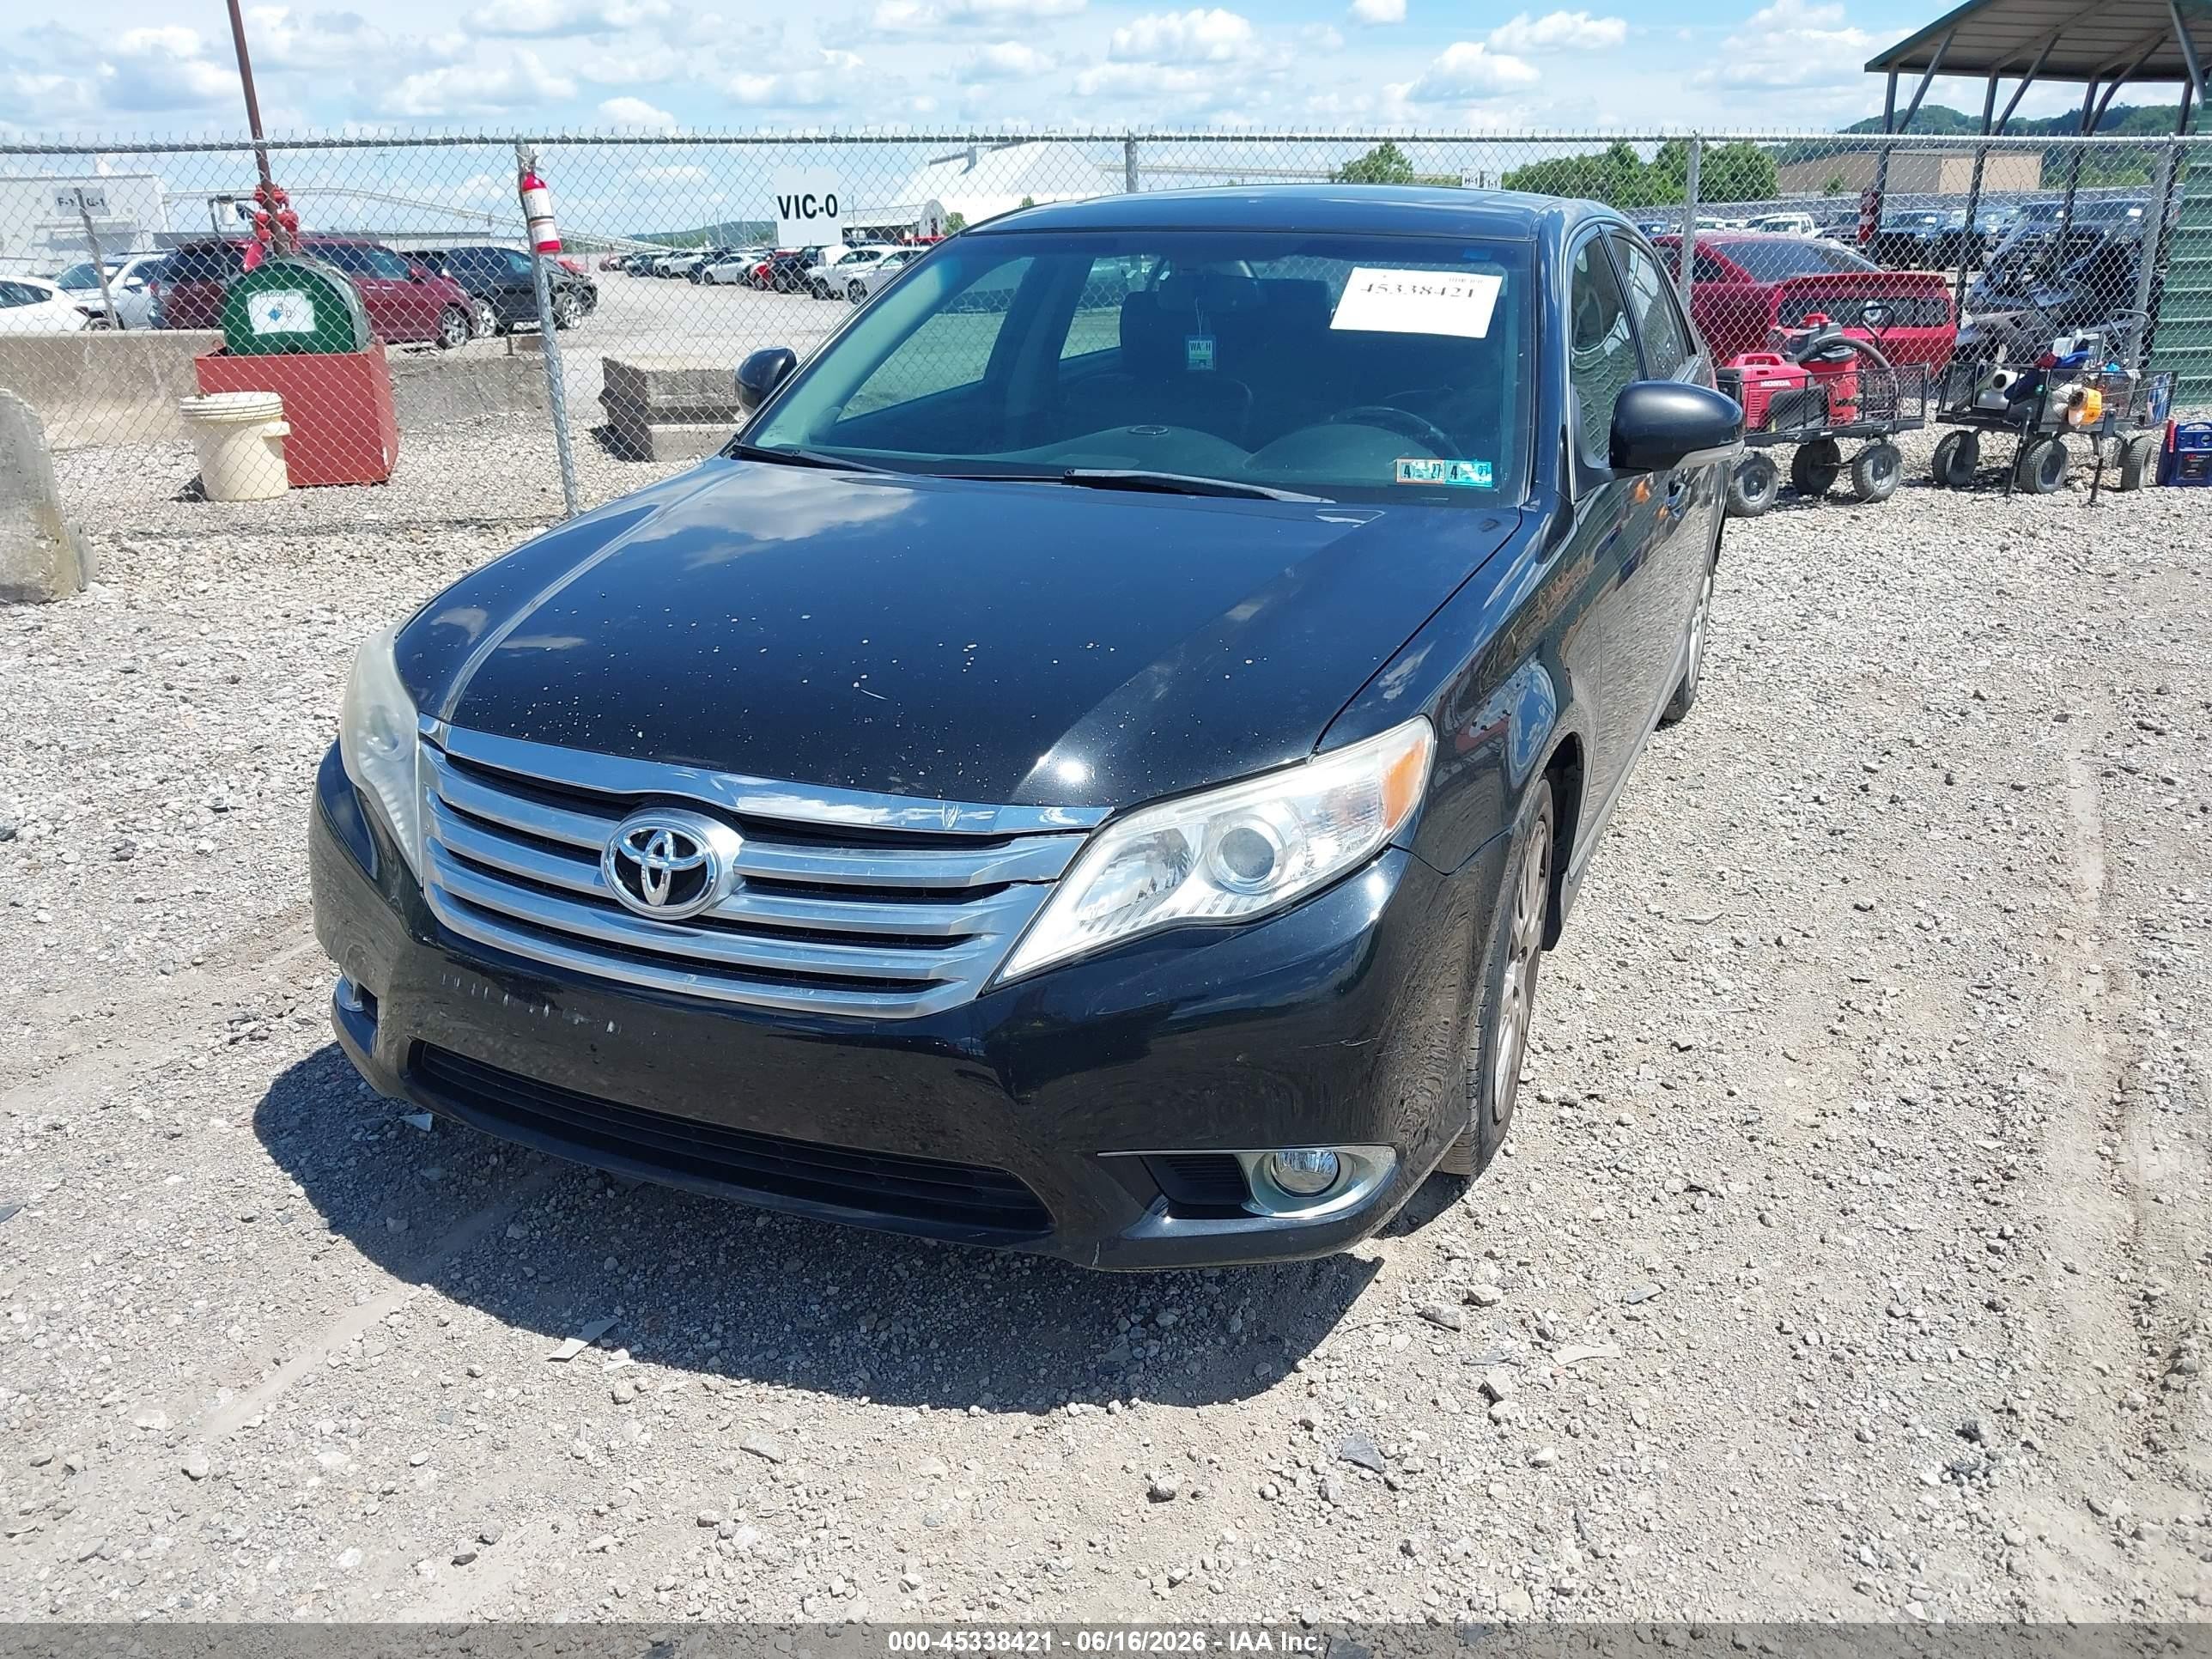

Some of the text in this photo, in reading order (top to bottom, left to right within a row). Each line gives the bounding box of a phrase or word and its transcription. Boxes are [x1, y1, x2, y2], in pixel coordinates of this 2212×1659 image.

[1360, 283, 1474, 298] 45338421
[1403, 465, 1411, 479] 4
[1450, 465, 1458, 480] 4
